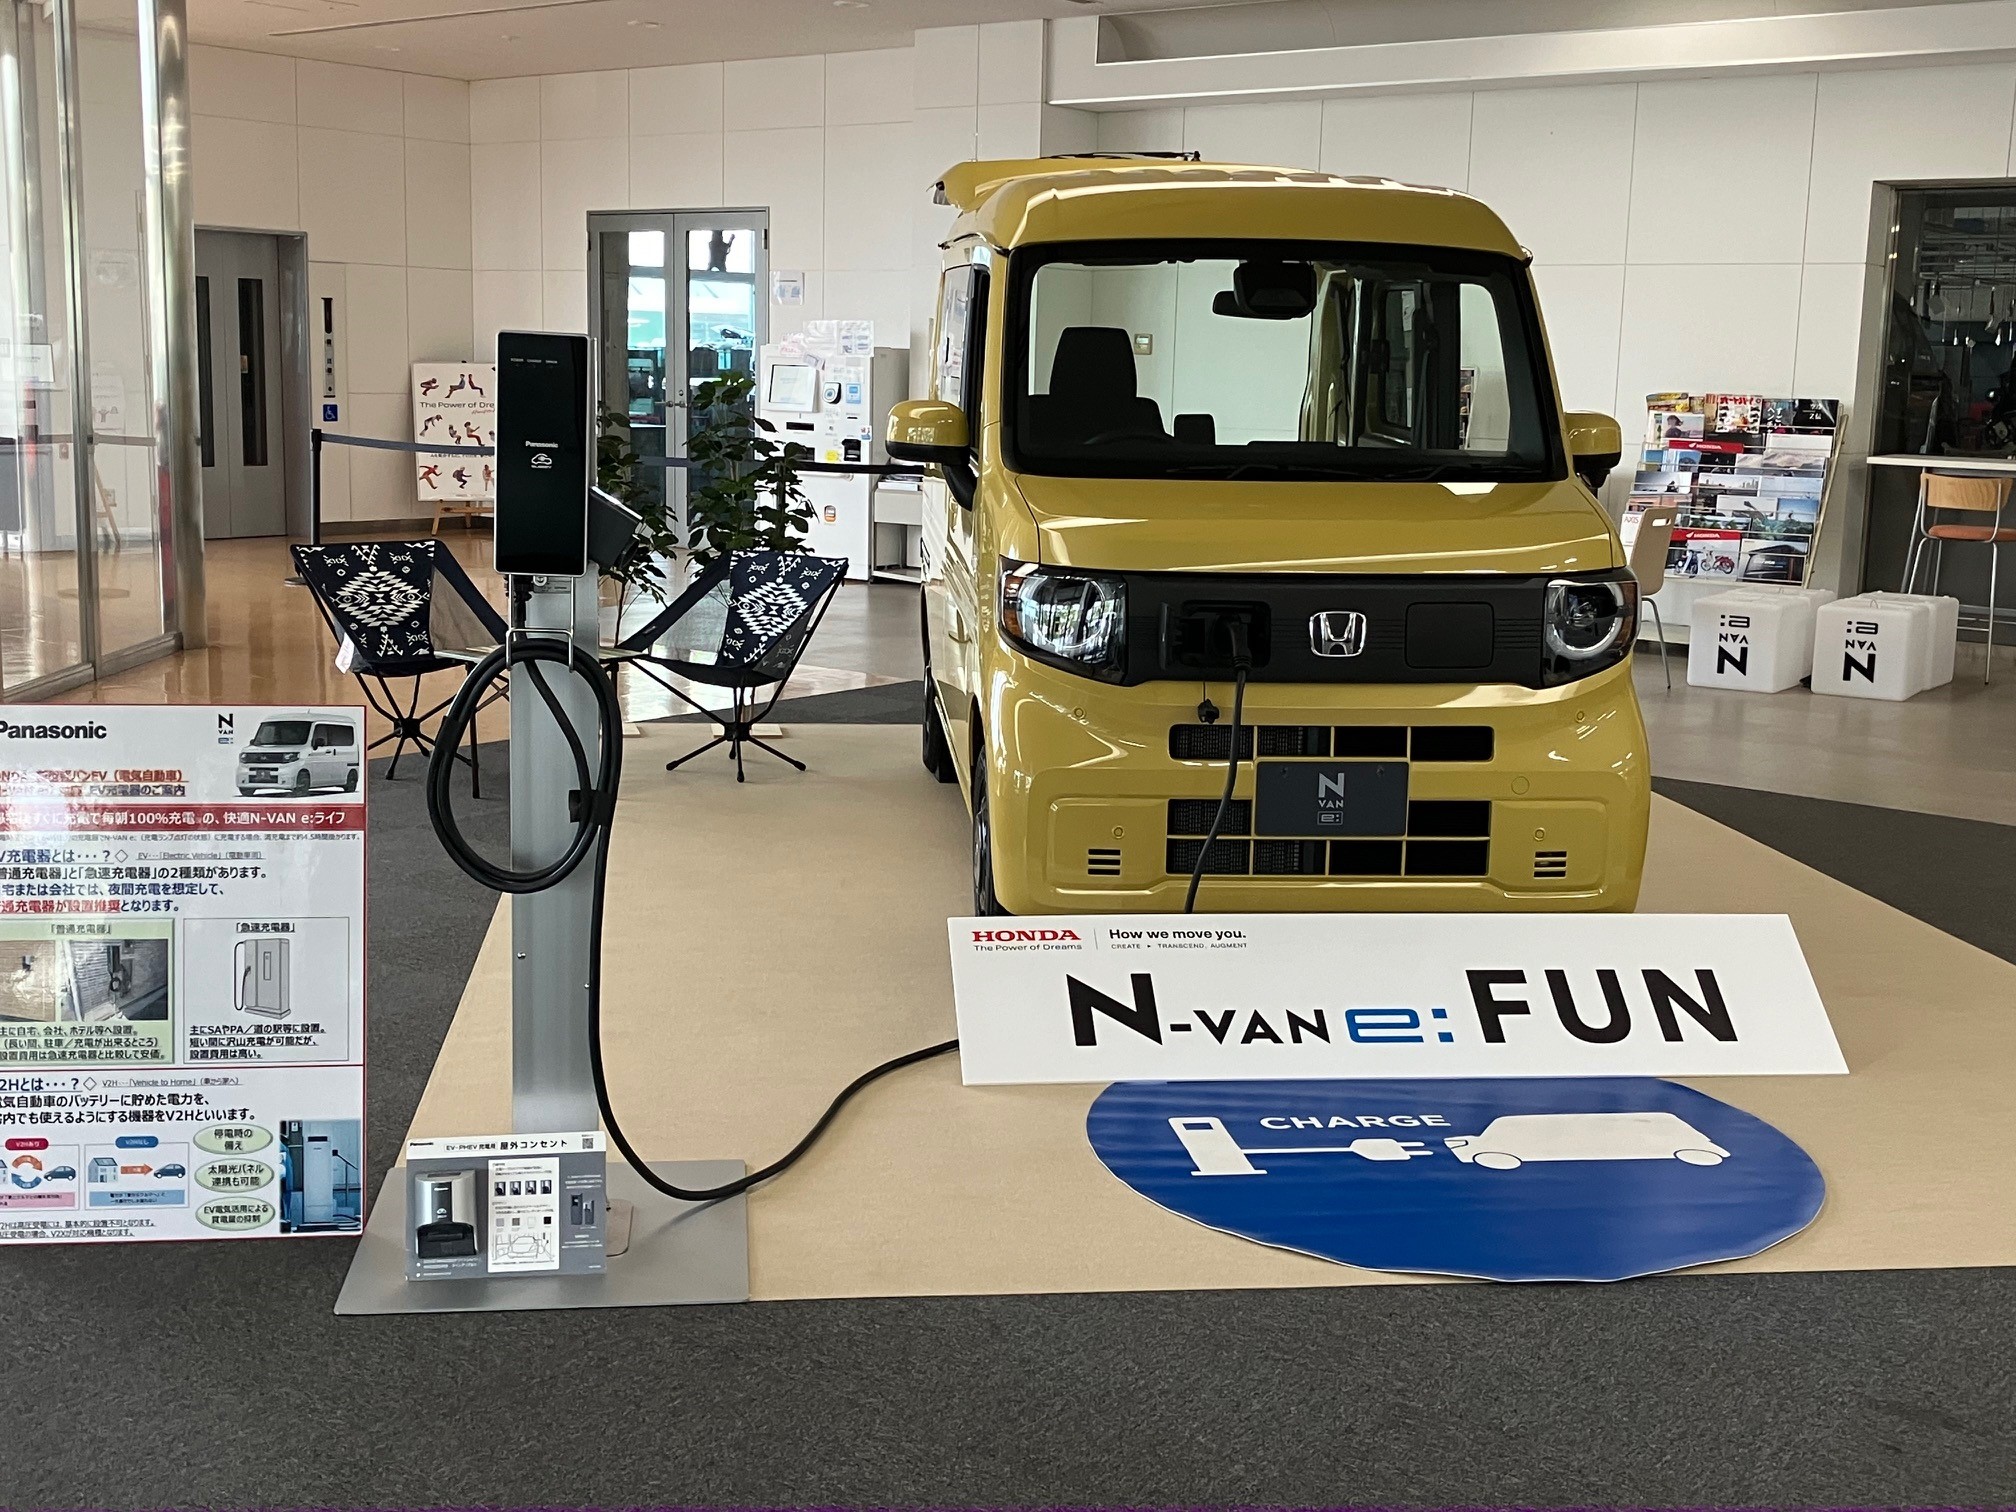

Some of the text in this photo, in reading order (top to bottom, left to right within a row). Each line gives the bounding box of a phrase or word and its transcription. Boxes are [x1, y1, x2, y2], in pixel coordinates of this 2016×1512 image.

[420, 401, 436, 409] The
[438, 401, 465, 409] Power
[218, 713, 234, 729] N
[1318, 772, 1345, 798] N
[1318, 800, 1344, 809] VAN
[971, 929, 1082, 942] HONDA
[1109, 928, 1247, 942] How we move you.
[1043, 943, 1083, 951] Dreams
[1066, 972, 1331, 1047] N-VAN
[1465, 969, 1739, 1045] FUN
[0, 1093, 209, 1109] 気自動車のバッテリーに貯めた電力を、
[0, 1107, 256, 1125] 内でも使えるようにする機器をV2Hといいます。
[1259, 1114, 1452, 1130] CHARGE
[500, 1138, 569, 1151] 屋外コンセント
